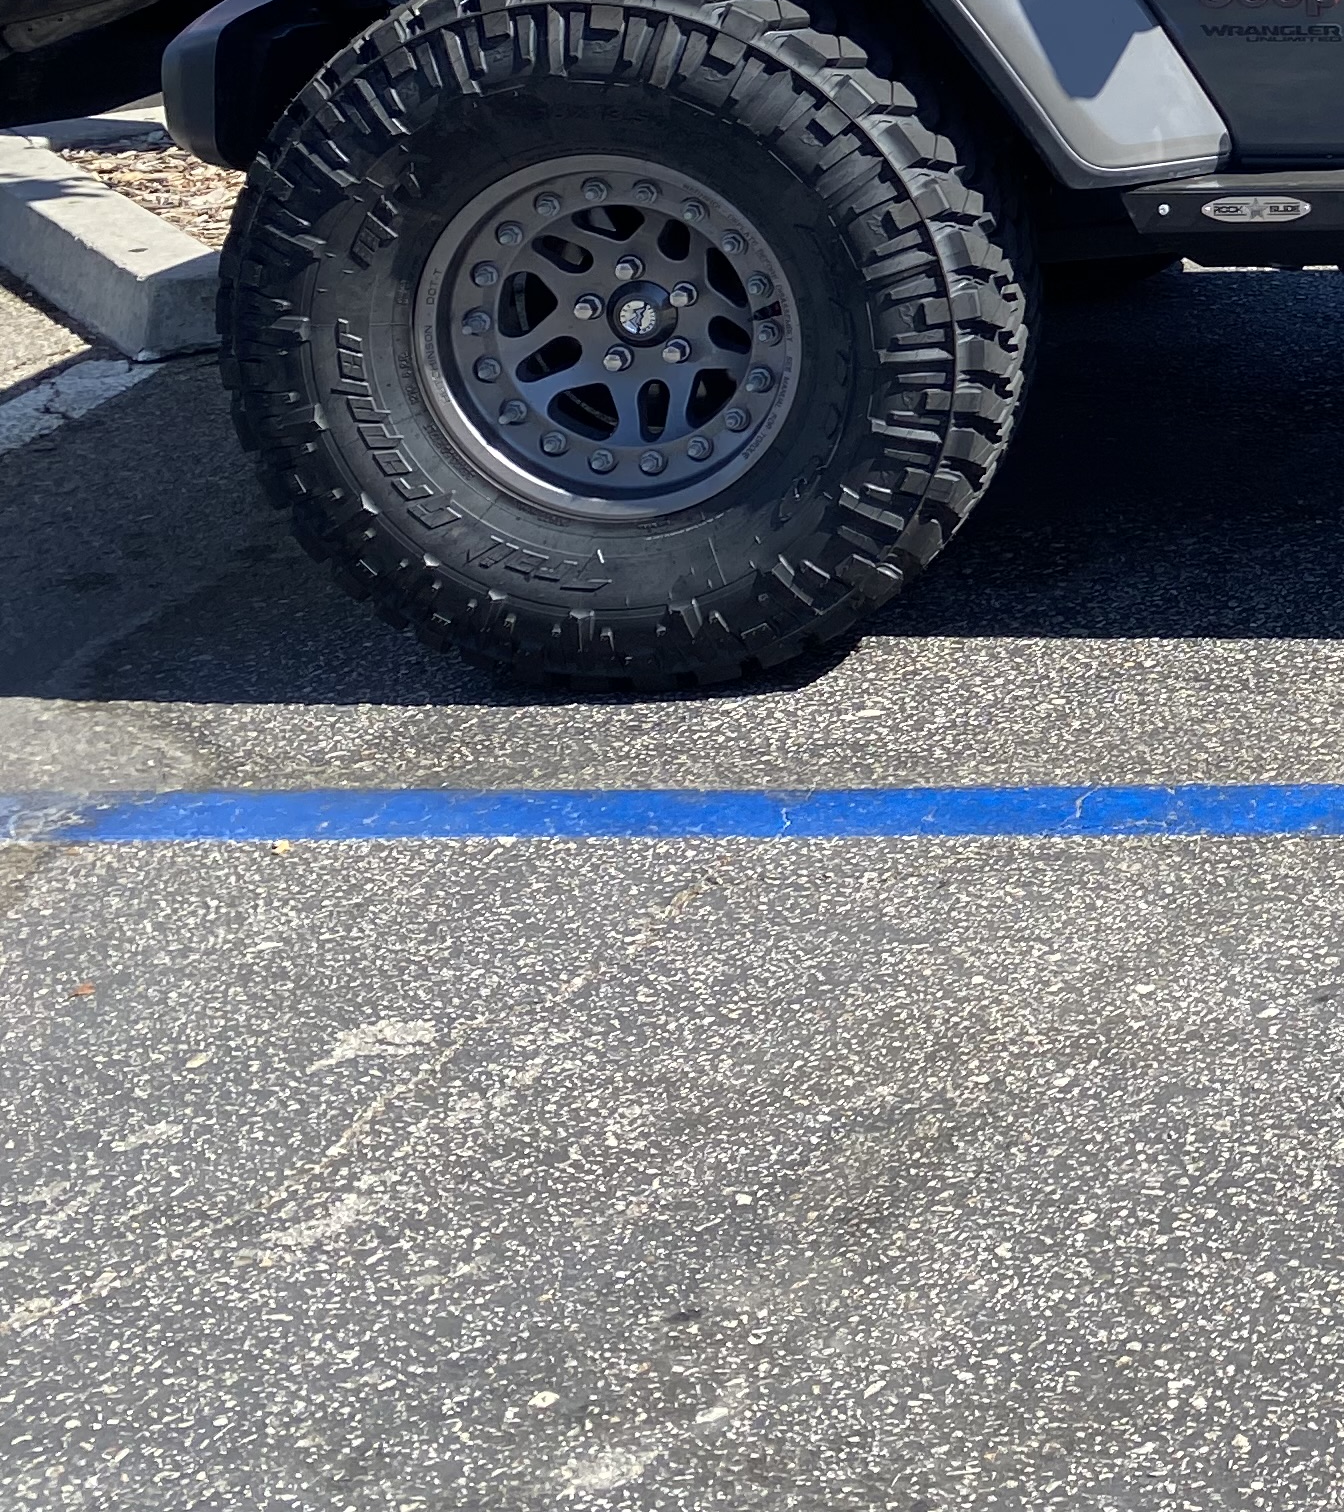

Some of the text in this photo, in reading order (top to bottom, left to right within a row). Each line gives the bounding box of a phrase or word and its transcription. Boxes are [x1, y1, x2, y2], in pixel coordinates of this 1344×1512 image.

[1200, 24, 1343, 37] WRANGLER
[1213, 205, 1244, 214] ROCK
[330, 317, 463, 530] Grappler
